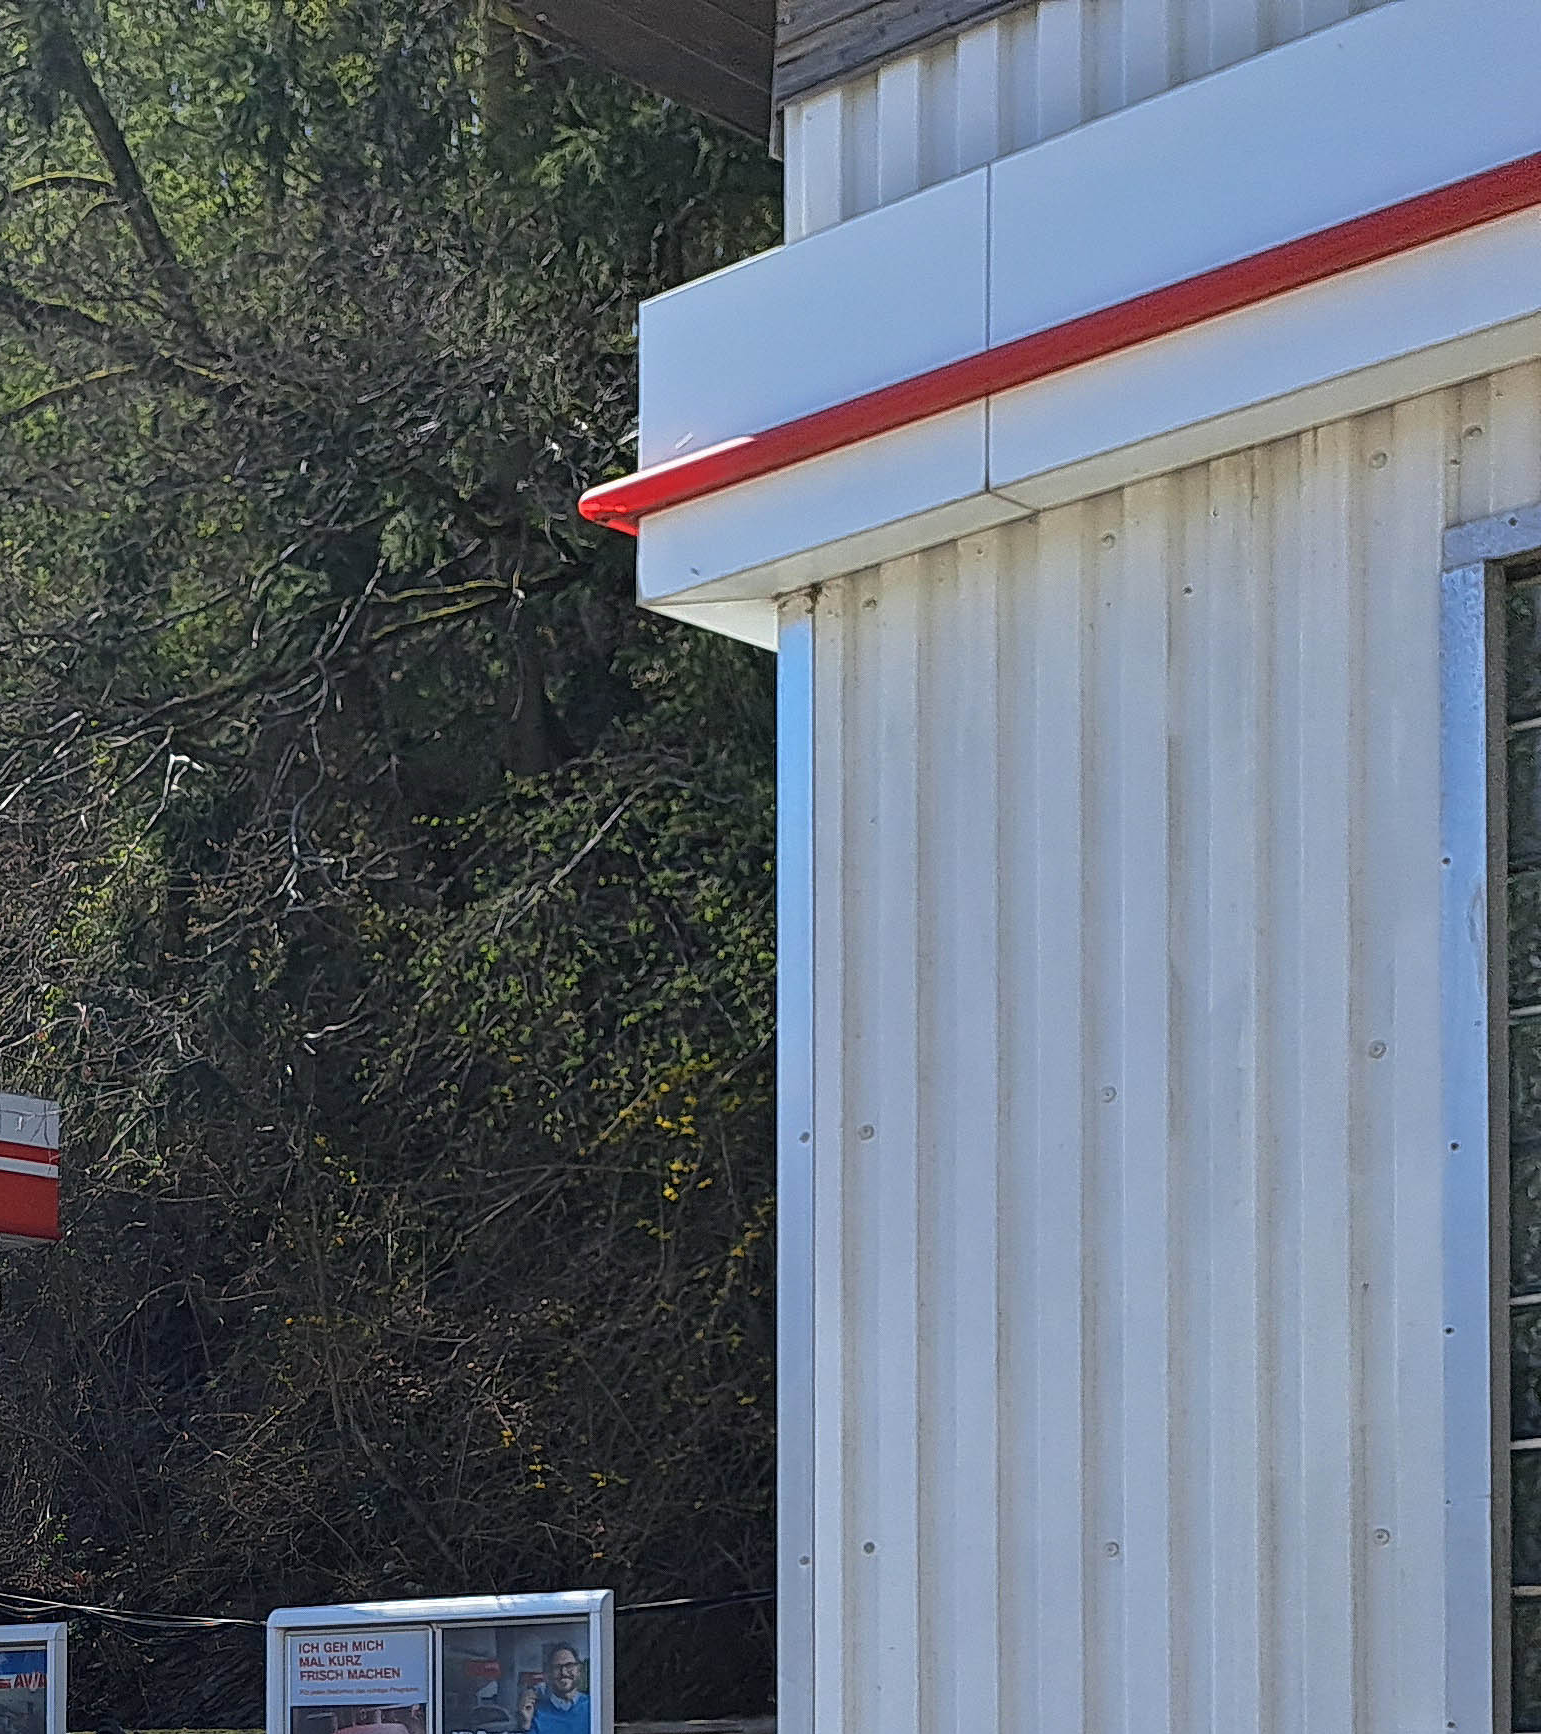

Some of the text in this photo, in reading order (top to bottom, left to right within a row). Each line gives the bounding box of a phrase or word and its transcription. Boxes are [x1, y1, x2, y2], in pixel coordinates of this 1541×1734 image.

[299, 1640, 384, 1654] ICH GEH MICH
[299, 1654, 363, 1667] MAL KURZ
[299, 1667, 401, 1681] FRISCH MACHEN
